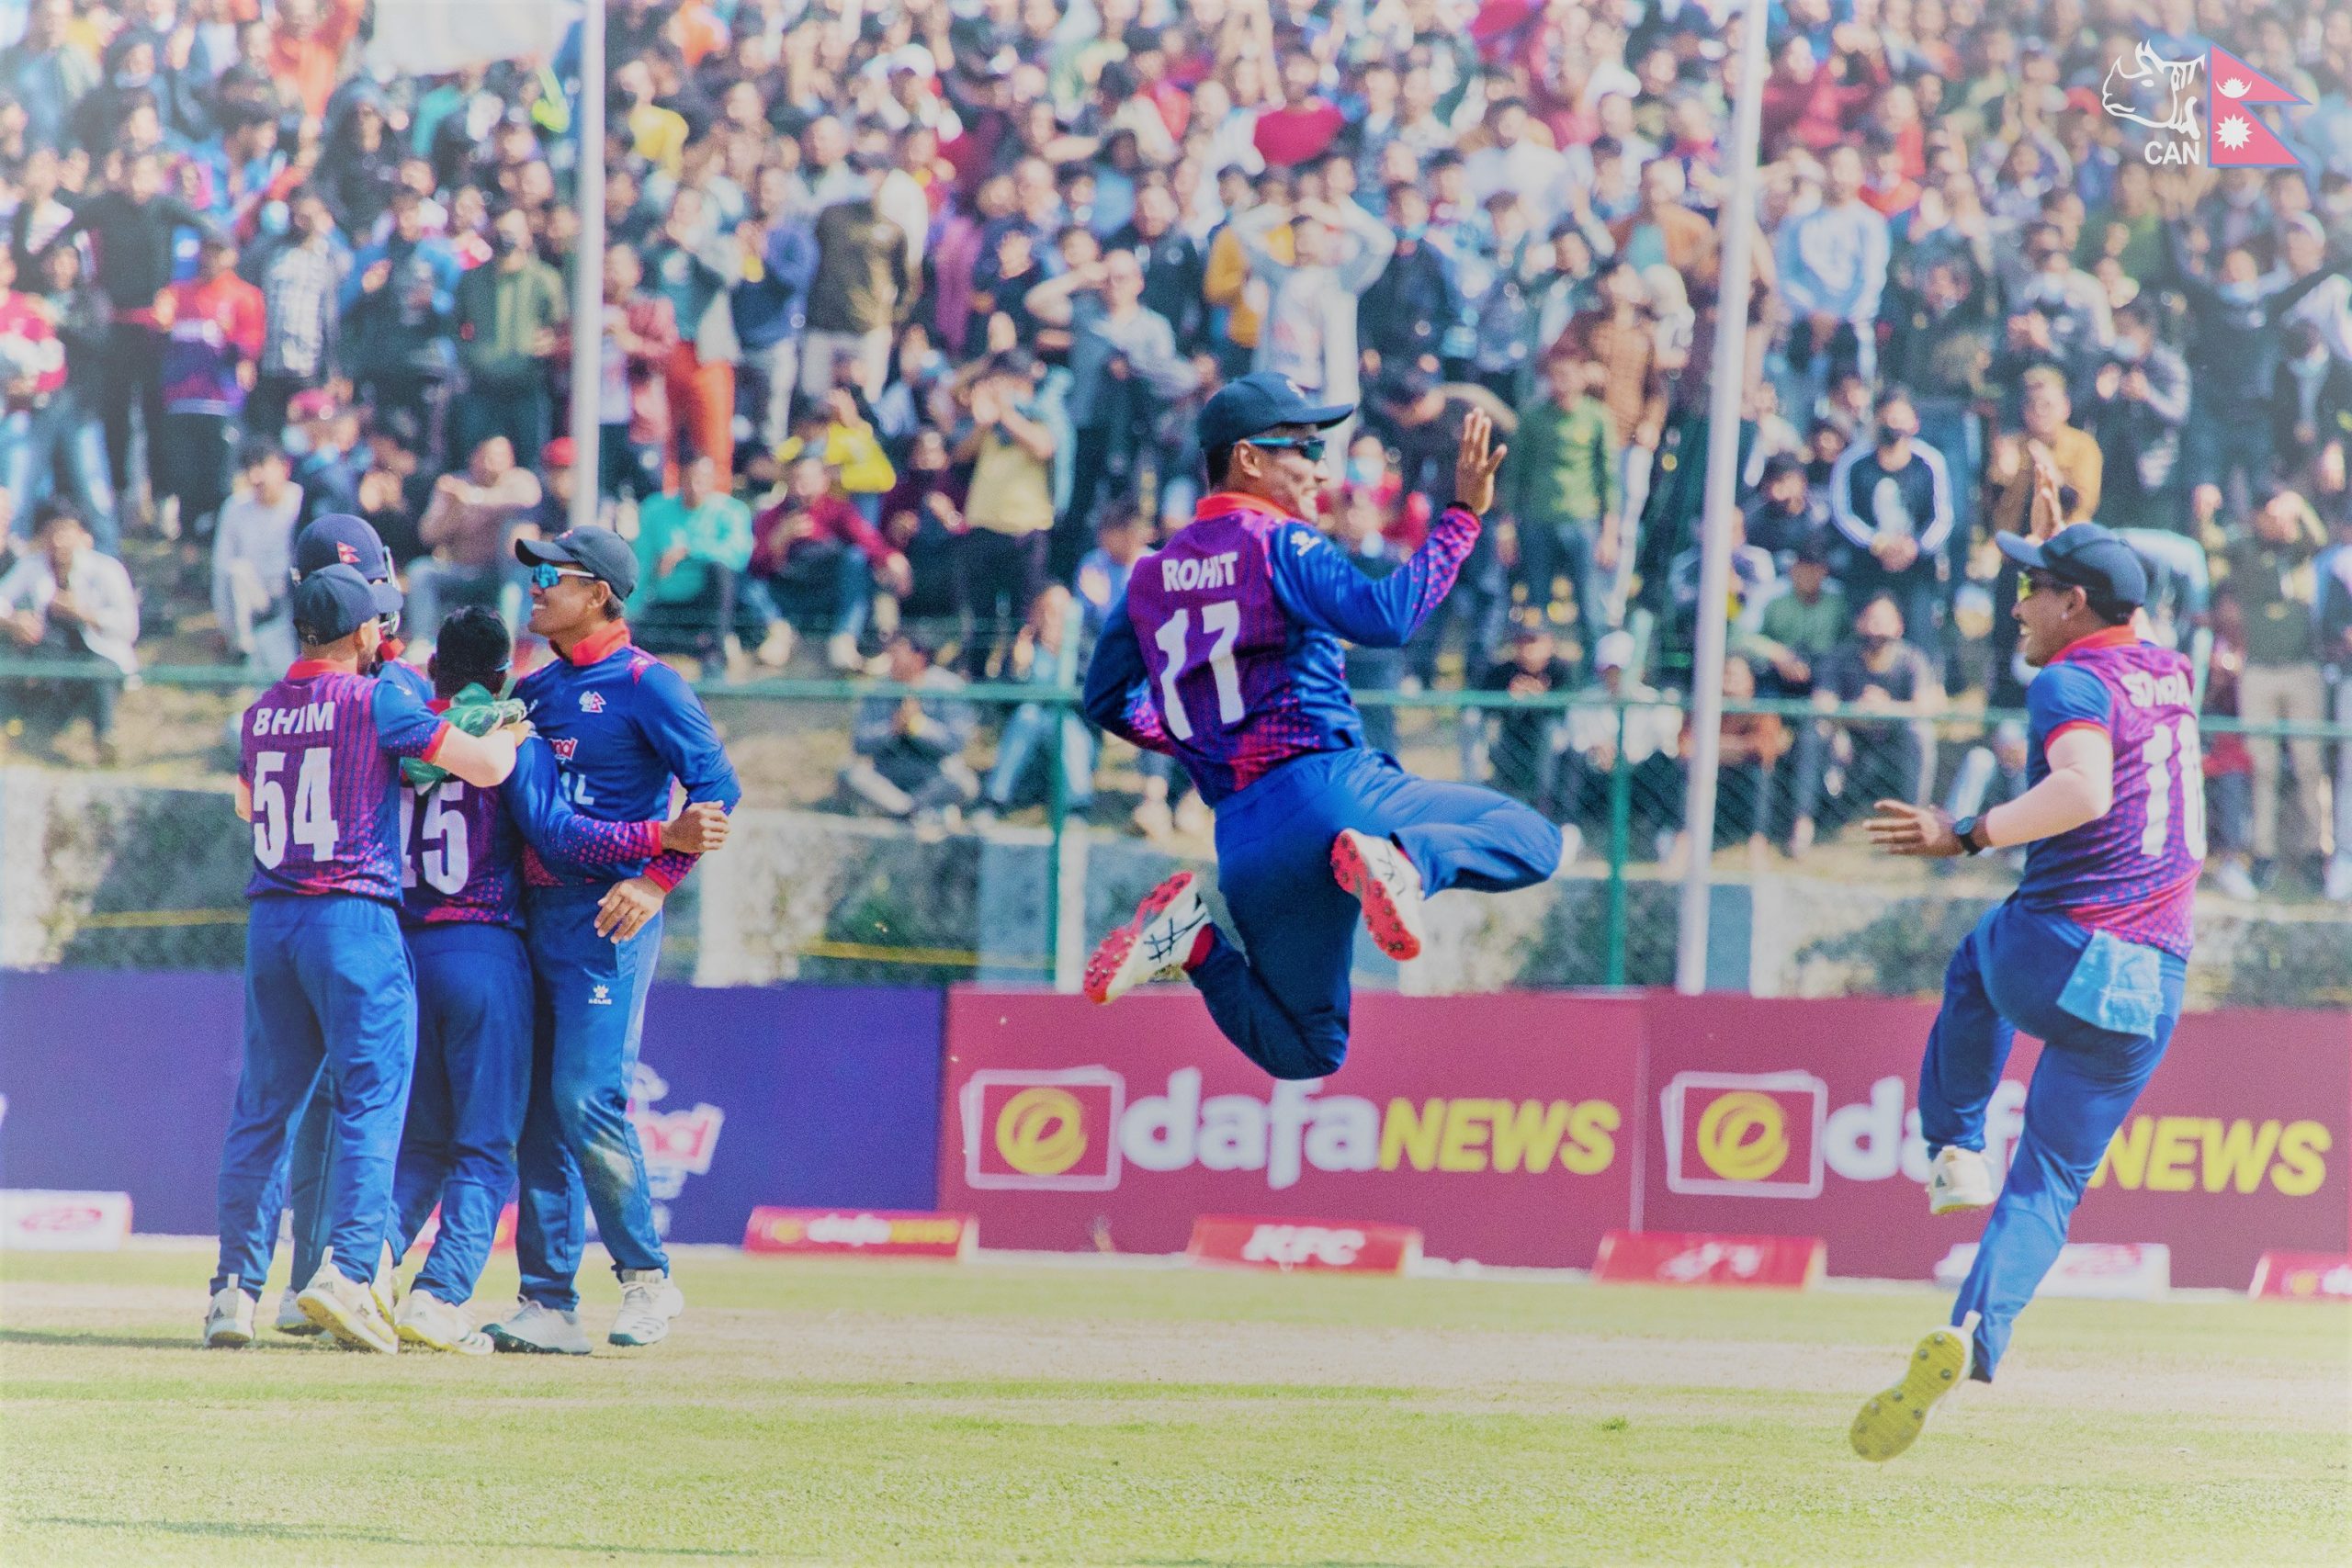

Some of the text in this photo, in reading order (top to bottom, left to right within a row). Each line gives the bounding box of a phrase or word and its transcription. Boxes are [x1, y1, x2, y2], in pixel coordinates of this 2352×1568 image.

[1161, 551, 1238, 592] ROHIT
[1154, 600, 1246, 741] 17
[252, 701, 336, 737] BHIM
[252, 746, 340, 870] 54
